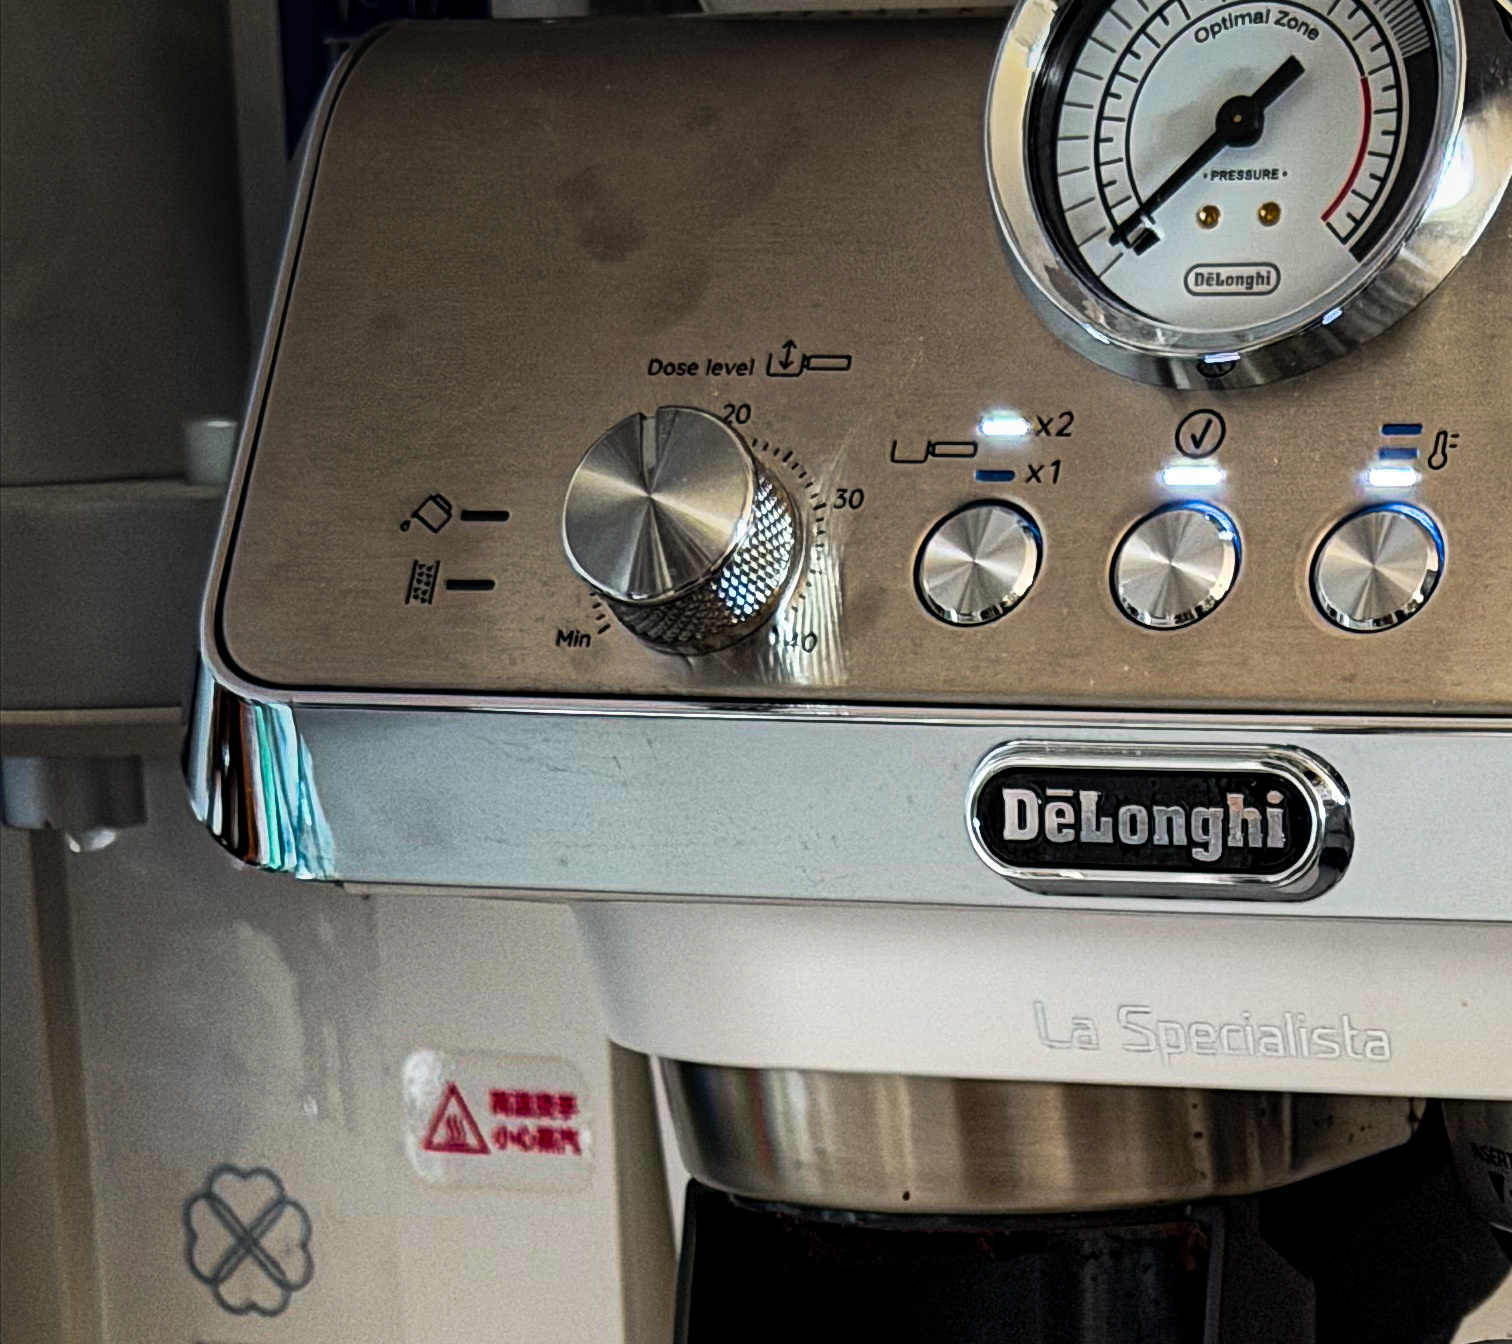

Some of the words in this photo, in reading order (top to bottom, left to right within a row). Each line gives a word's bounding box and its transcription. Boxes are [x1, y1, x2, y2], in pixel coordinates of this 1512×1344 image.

[1193, 6, 1270, 45] Optimal
[1273, 9, 1321, 42] Zone
[1210, 168, 1280, 182] PRESSURE
[647, 357, 700, 378] Dose
[704, 357, 755, 378] level
[722, 403, 752, 425] 20
[833, 488, 865, 511] 30
[555, 628, 591, 649] Min
[1032, 1000, 1100, 1052] La
[1116, 1003, 1393, 1067] Specialista
